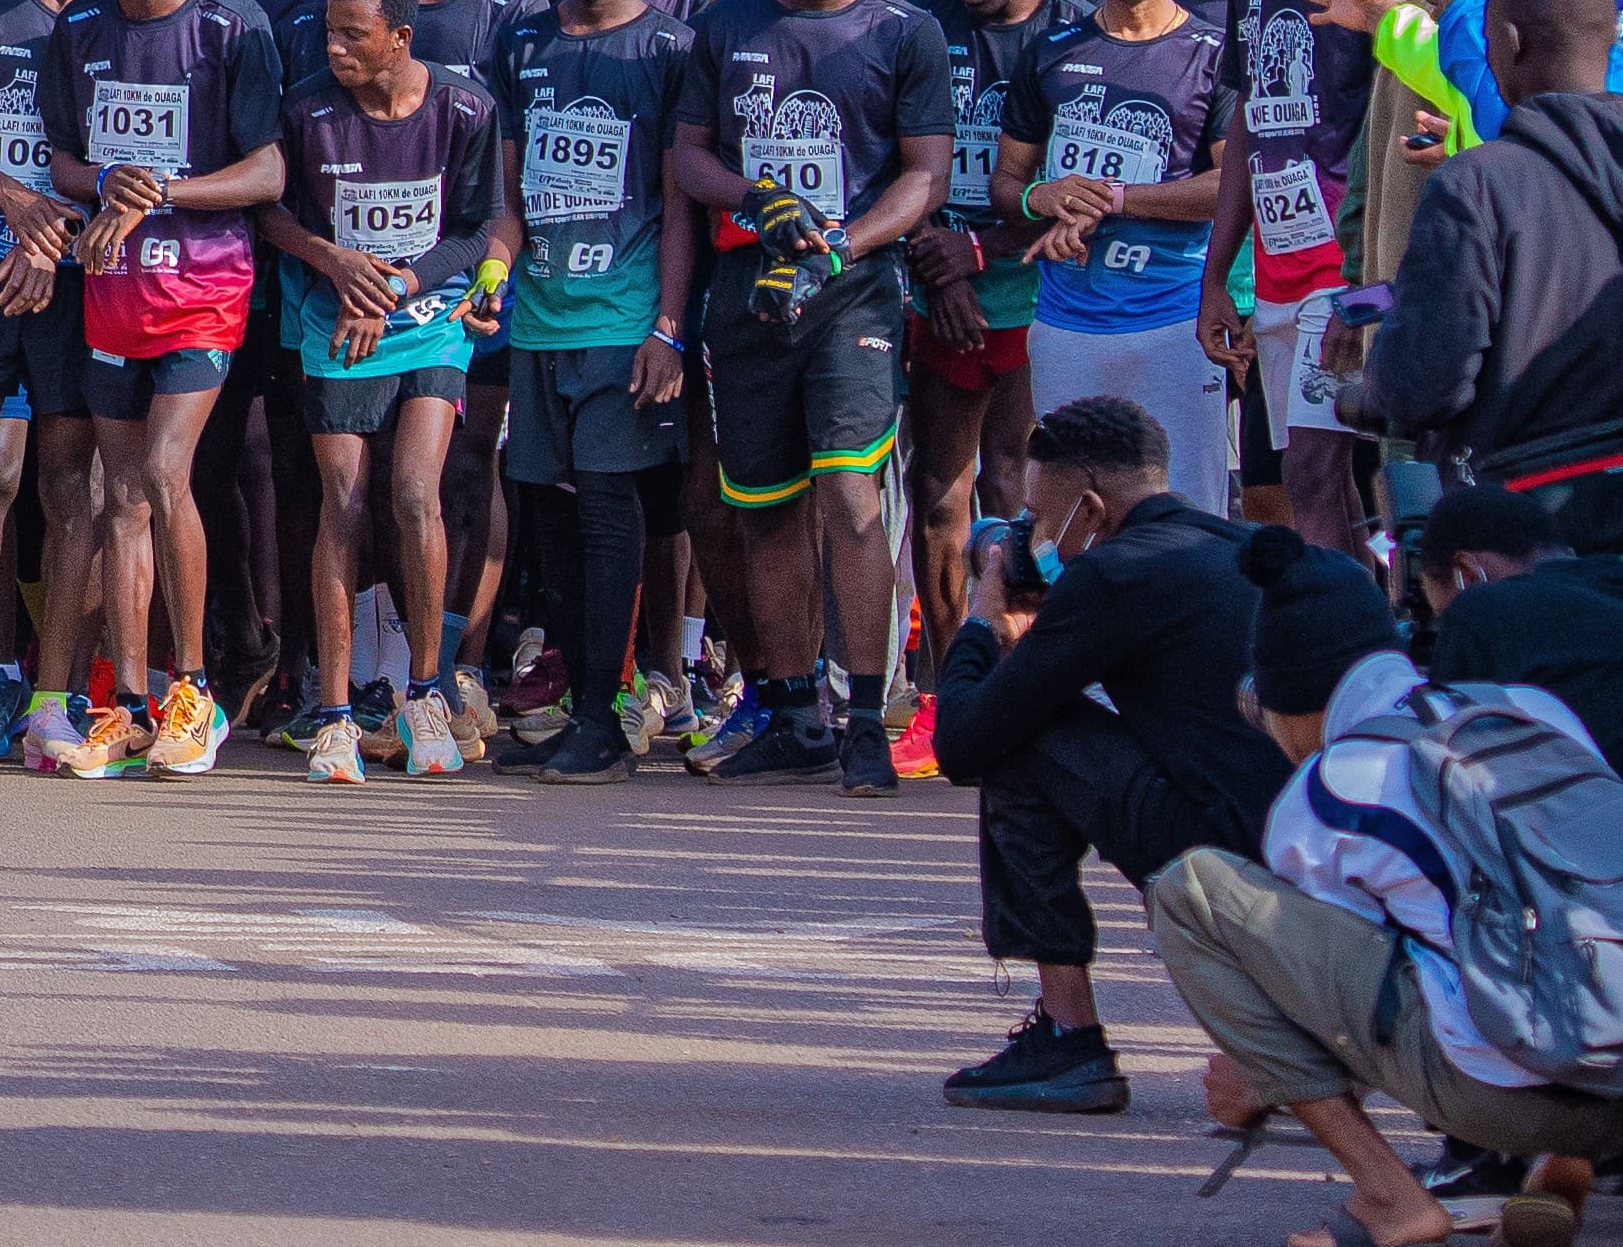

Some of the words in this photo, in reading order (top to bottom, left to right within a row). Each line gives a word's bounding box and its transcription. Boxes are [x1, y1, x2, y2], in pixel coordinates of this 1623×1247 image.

[15, 68, 37, 81] LAFI
[753, 73, 775, 84] LAFI
[953, 68, 974, 77] LAFI
[110, 88, 122, 100] LAFI
[123, 89, 142, 101] 10KM
[143, 90, 153, 101] de
[154, 91, 182, 103] OUAGA
[535, 87, 554, 97] LAFI
[1084, 84, 1106, 95] LAFI
[2, 120, 19, 133] LAFI
[21, 120, 42, 133] 10KM
[98, 105, 174, 138] 1031
[550, 117, 564, 129] LAFI
[566, 120, 584, 132] 10KM
[586, 123, 594, 133] de
[597, 125, 625, 137] OUAGA
[1070, 125, 1085, 138] LAFI
[1087, 129, 1105, 143] 10KM
[1106, 133, 1115, 144] de
[1117, 135, 1145, 151] OUAGA
[534, 135, 618, 170] 1895
[763, 145, 774, 155] LAFI
[776, 145, 795, 157] 10KM
[796, 144, 806, 156] de
[808, 144, 836, 156] OUAGA
[1061, 142, 1123, 178] 818
[759, 163, 822, 191] 610
[1281, 170, 1308, 187] OUAGA
[358, 188, 376, 199] LAFI
[379, 188, 400, 199] 10KM
[402, 187, 411, 198] de
[413, 185, 438, 198] OUAGA
[544, 192, 561, 211] DE
[1257, 188, 1317, 224] 1824
[344, 200, 435, 231] 1054
